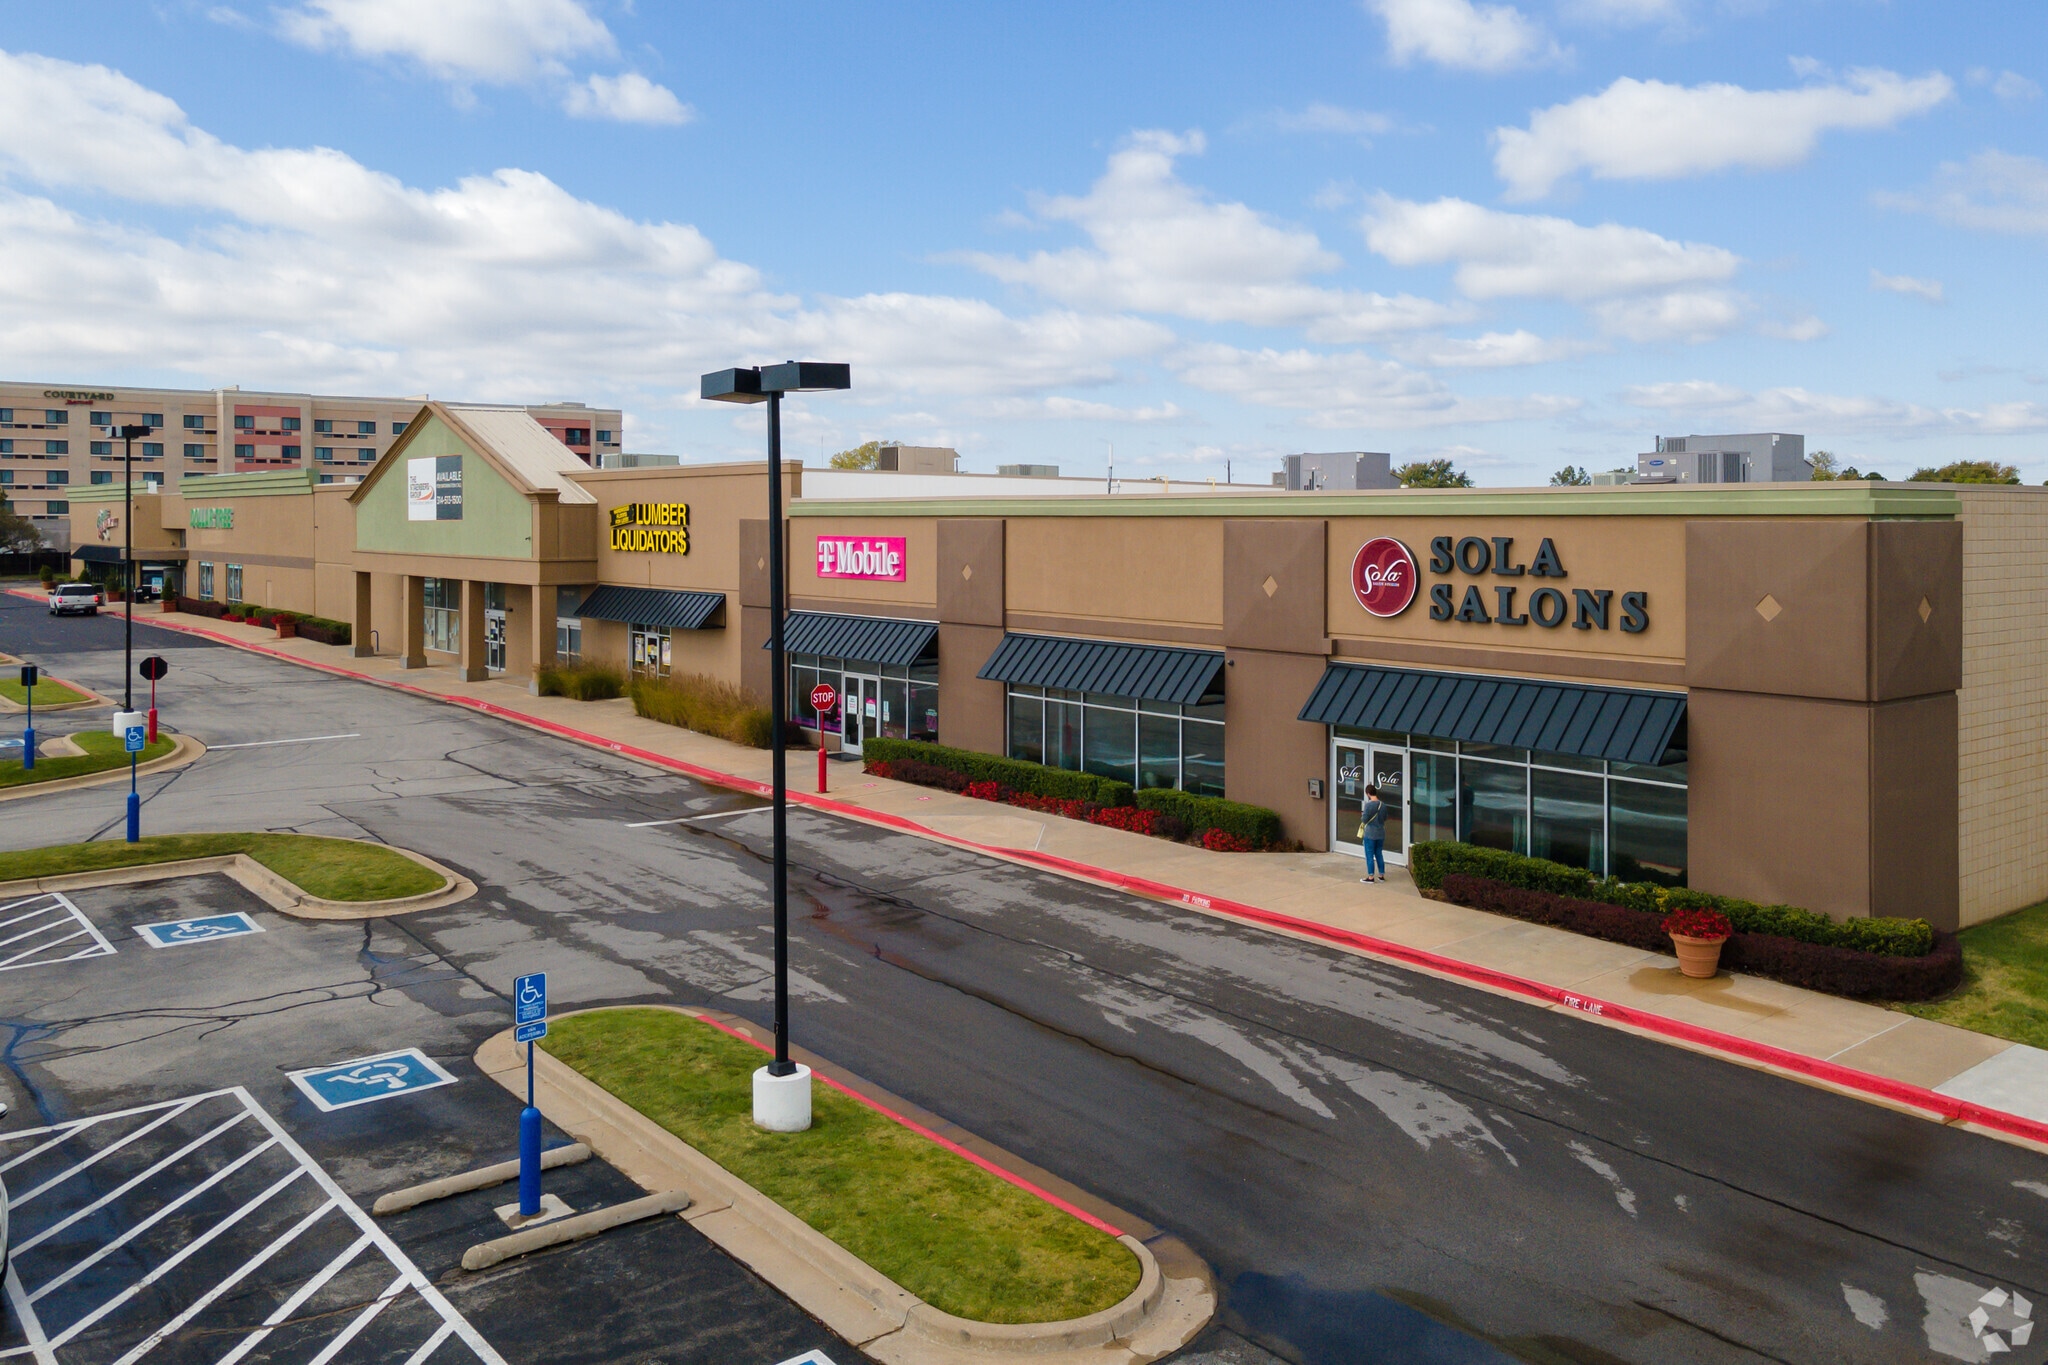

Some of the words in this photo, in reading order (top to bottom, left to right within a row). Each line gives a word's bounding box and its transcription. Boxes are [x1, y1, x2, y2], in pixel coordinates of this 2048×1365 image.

[43, 390, 115, 401] COURTYARD
[436, 470, 462, 482] AVAILABLE
[635, 503, 689, 526] LUMBER
[1429, 536, 1568, 577] SOLA
[1360, 559, 1407, 595] Sola
[1429, 583, 1650, 634] SALONS
[812, 691, 834, 704] STOP
[1337, 765, 1363, 784] Sola
[1374, 771, 1402, 790] Sola
[1563, 995, 1581, 1009] FIRE
[1583, 1000, 1604, 1015] LANE
